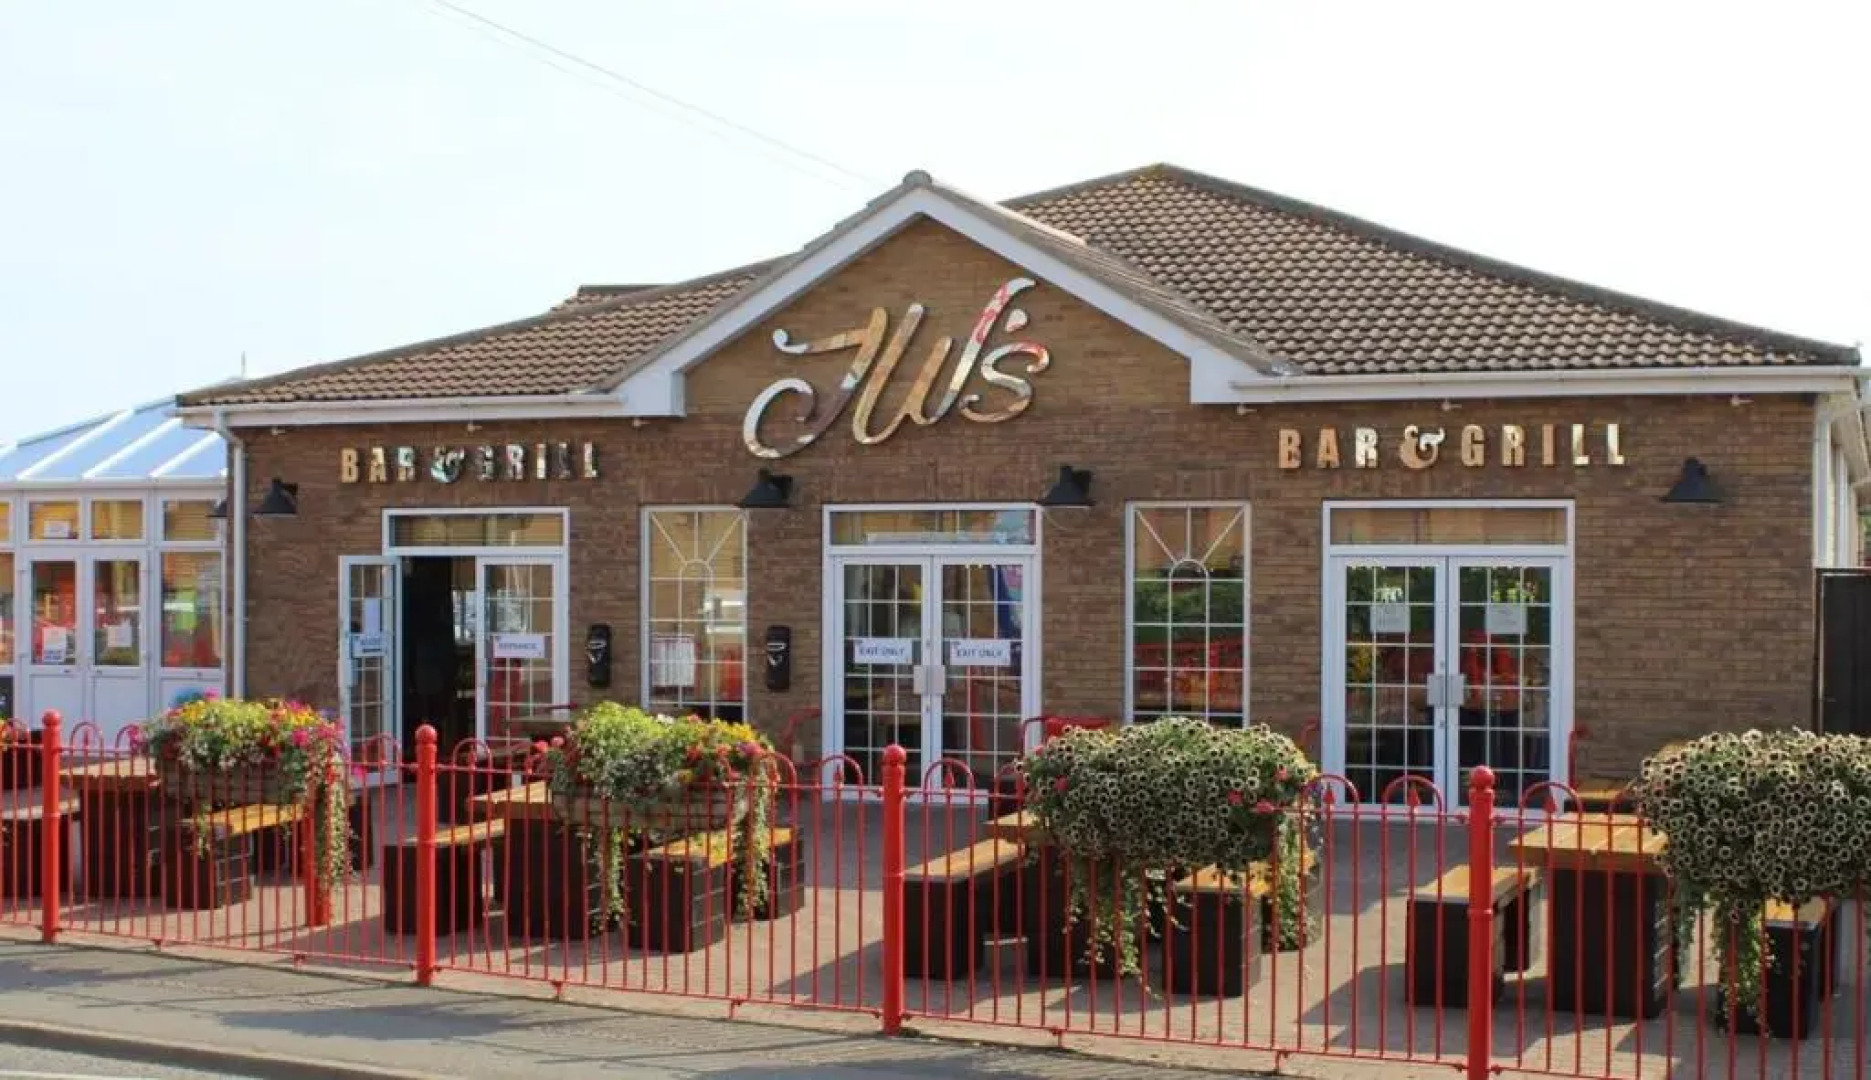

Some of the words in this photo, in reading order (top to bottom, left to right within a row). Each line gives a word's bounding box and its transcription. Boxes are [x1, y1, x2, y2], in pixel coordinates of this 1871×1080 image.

[1277, 426, 1379, 469] BAR
[1399, 424, 1446, 469] &
[1460, 423, 1625, 468] GRILL
[340, 445, 416, 484] BAR
[430, 446, 466, 484] &
[475, 442, 598, 482] GRILL
[859, 646, 878, 656] EXIT
[881, 646, 905, 656] ONLY
[956, 648, 976, 657] EXIT
[979, 648, 1002, 658] ONLY
